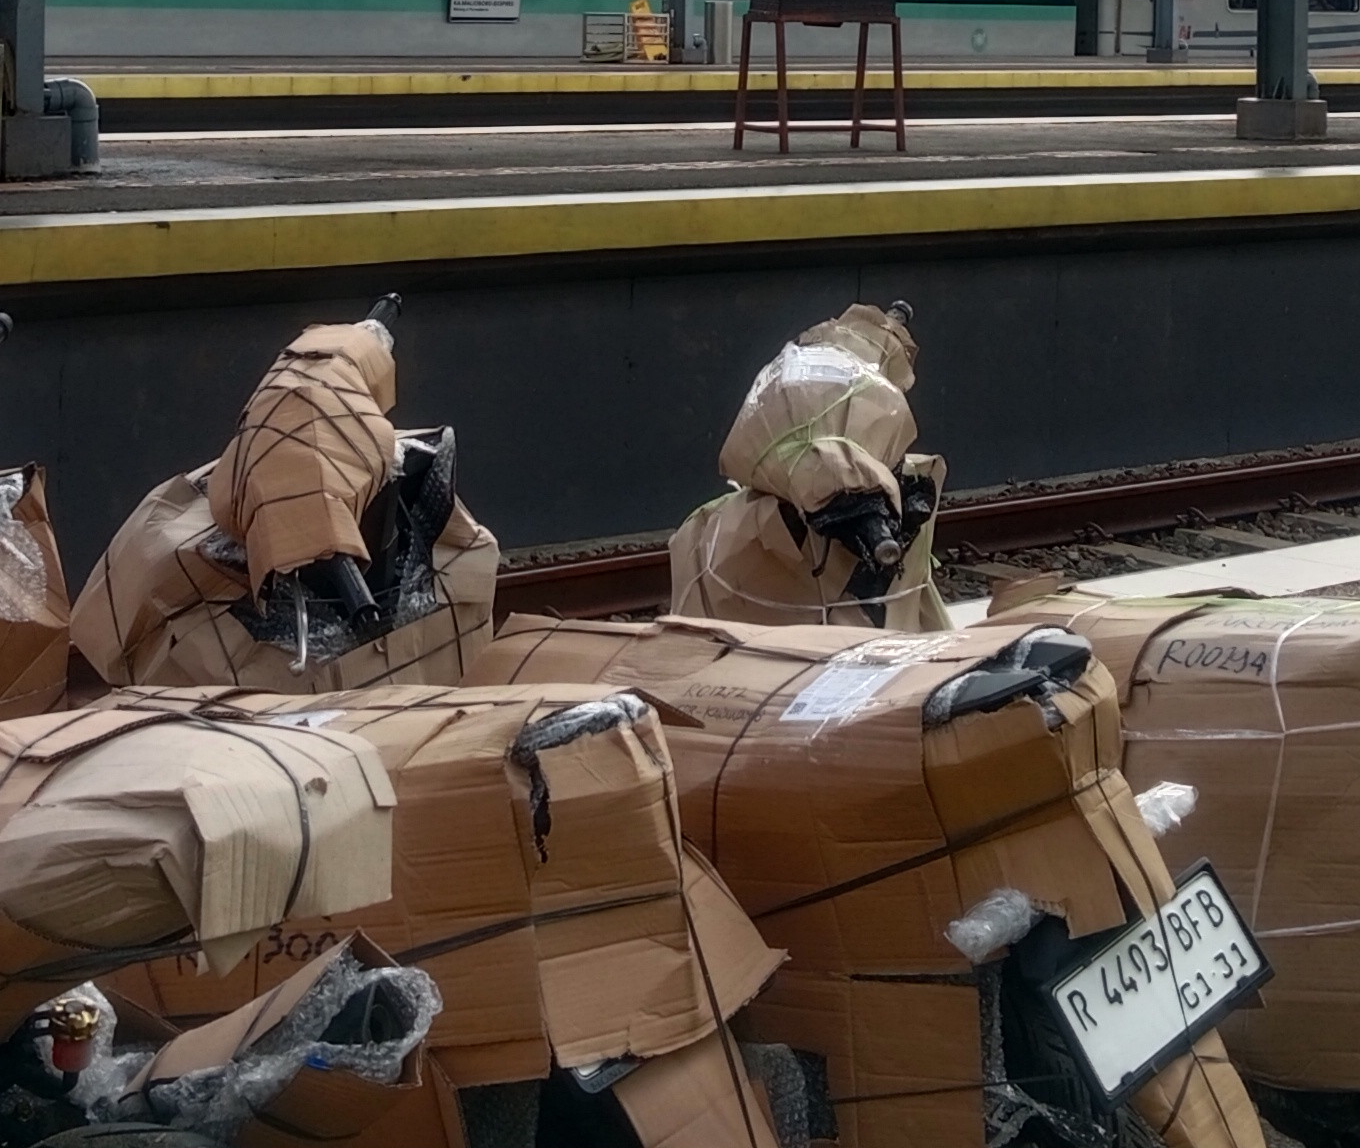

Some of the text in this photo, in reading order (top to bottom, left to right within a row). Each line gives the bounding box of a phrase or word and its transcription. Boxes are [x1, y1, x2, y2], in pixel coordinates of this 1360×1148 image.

[1067, 889, 1225, 1031] R 4493 BFB
